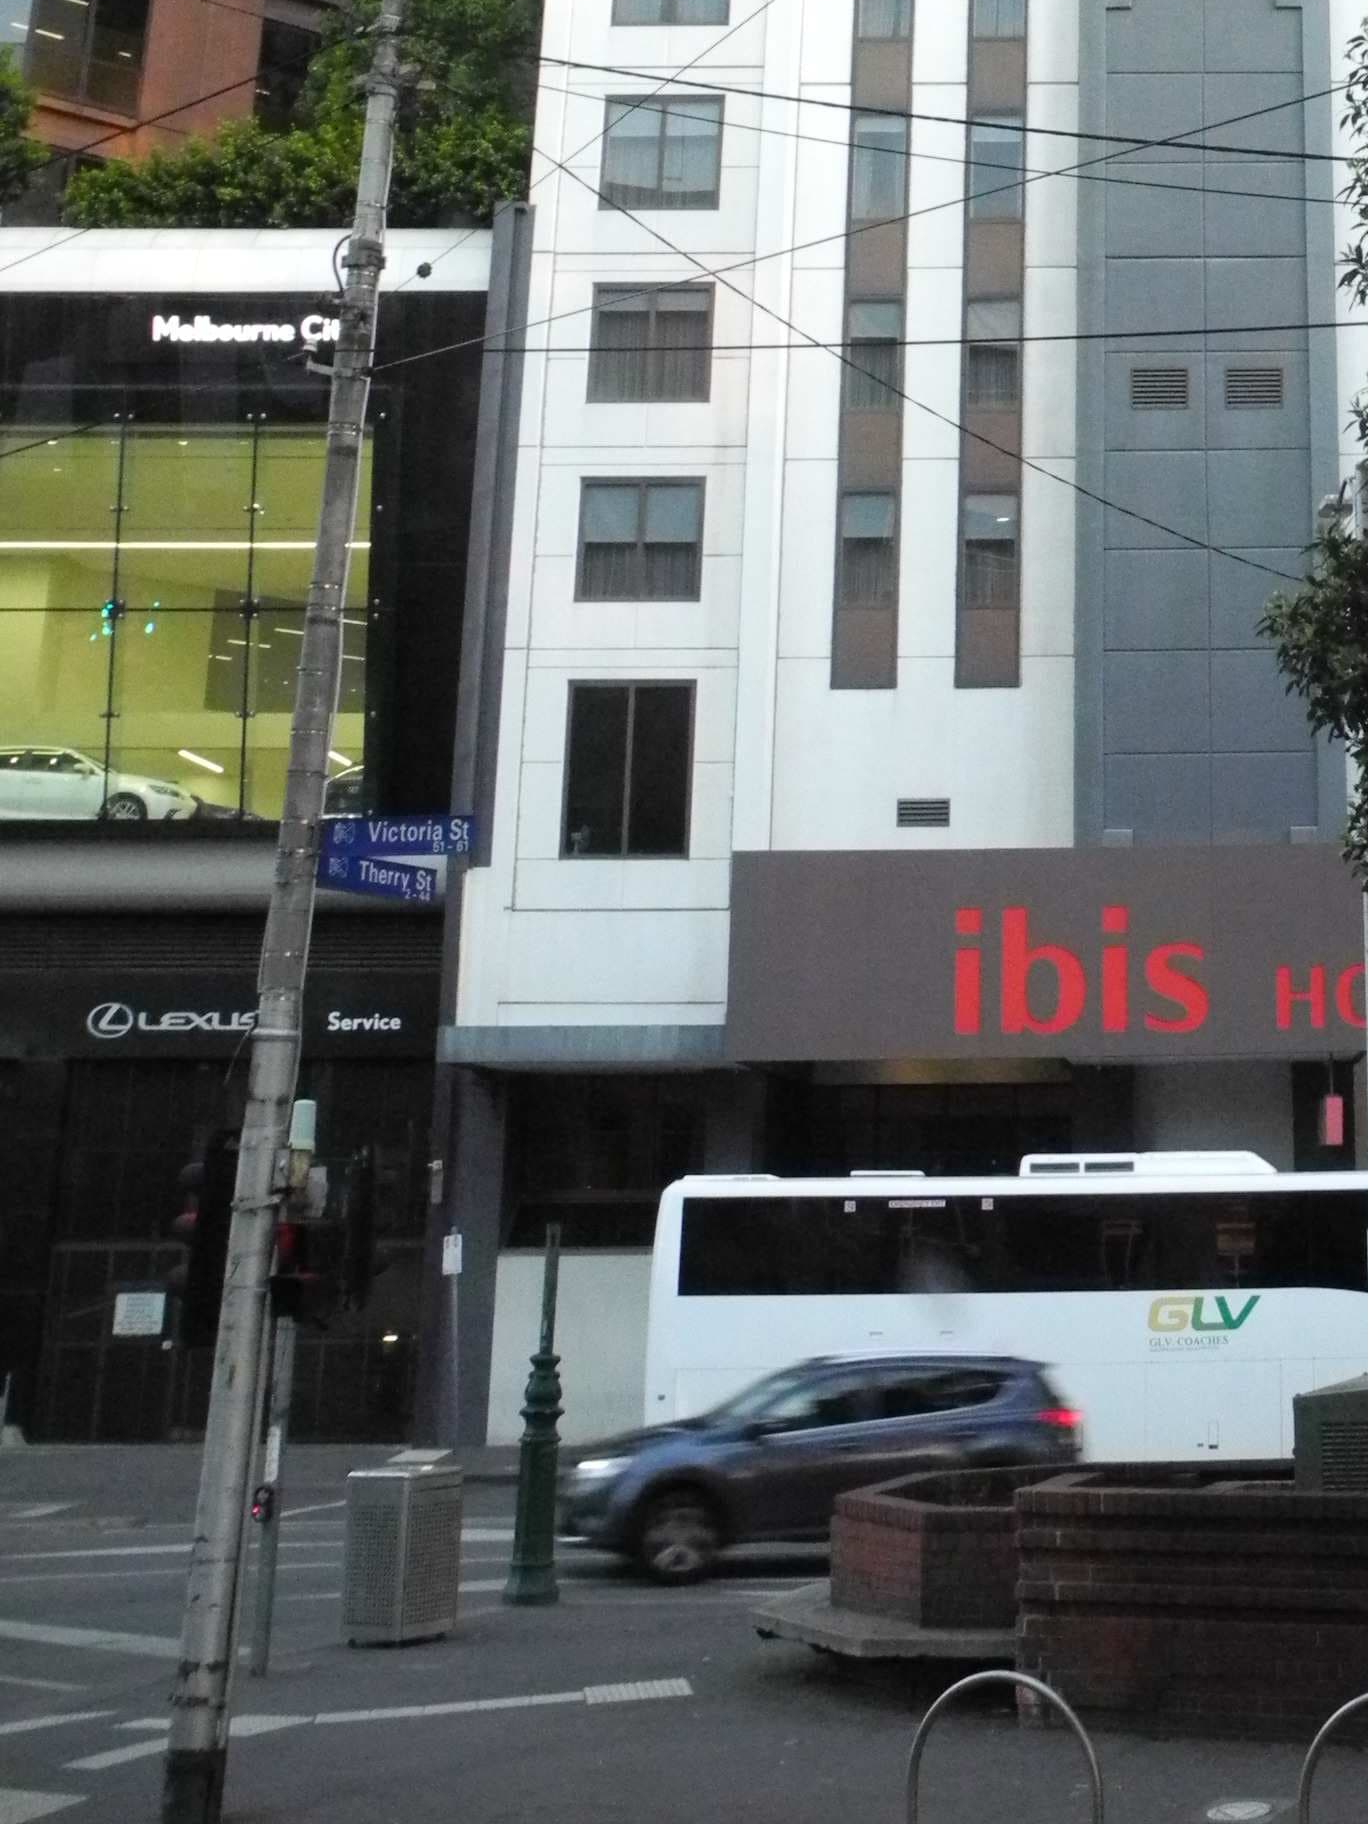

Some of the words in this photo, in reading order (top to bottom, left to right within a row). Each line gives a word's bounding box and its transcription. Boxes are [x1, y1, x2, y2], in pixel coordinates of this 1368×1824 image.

[152, 315, 296, 342] Melbourne
[301, 315, 341, 341] Cit
[368, 821, 443, 842] Victoria
[451, 819, 469, 841] St
[360, 860, 409, 890] Therry
[416, 870, 431, 892] St
[954, 906, 1210, 1035] ibis
[328, 1012, 401, 1031] Service
[1148, 1295, 1261, 1331] GLV
